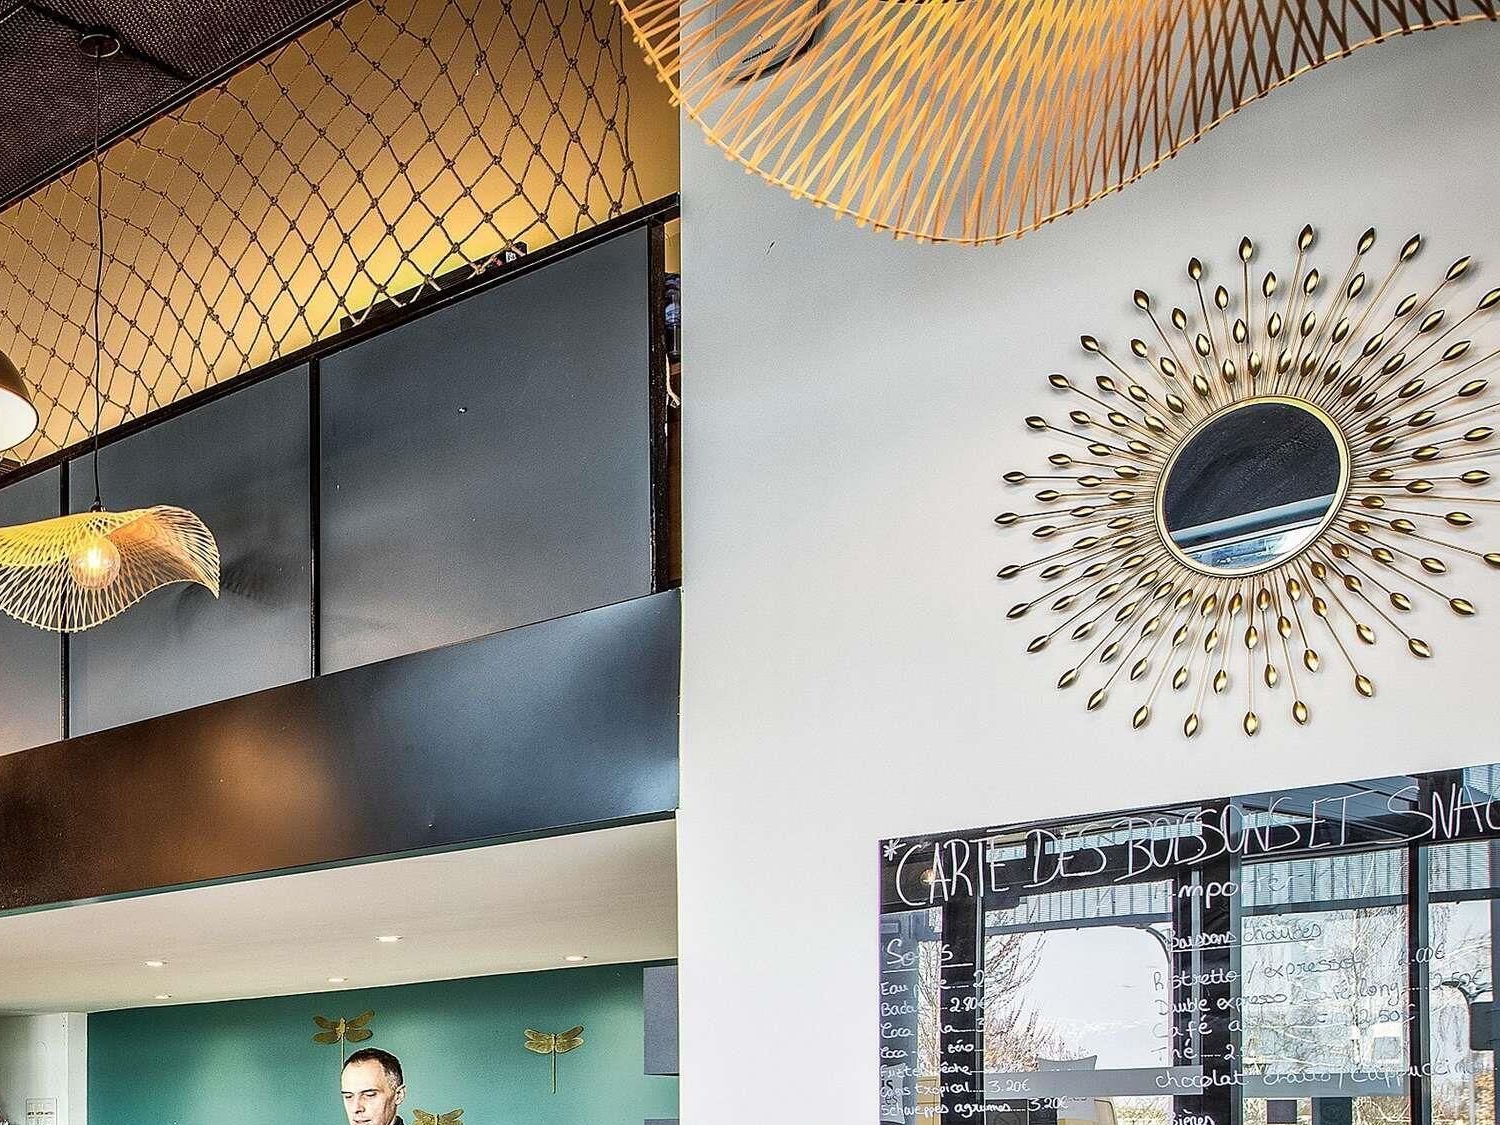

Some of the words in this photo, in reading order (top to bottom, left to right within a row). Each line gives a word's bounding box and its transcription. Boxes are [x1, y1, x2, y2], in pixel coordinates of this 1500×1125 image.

[1023, 827, 1107, 888] DES
[1112, 797, 1301, 882] BOISSONS
[1307, 789, 1377, 850] ET
[880, 981, 910, 997] Eau
